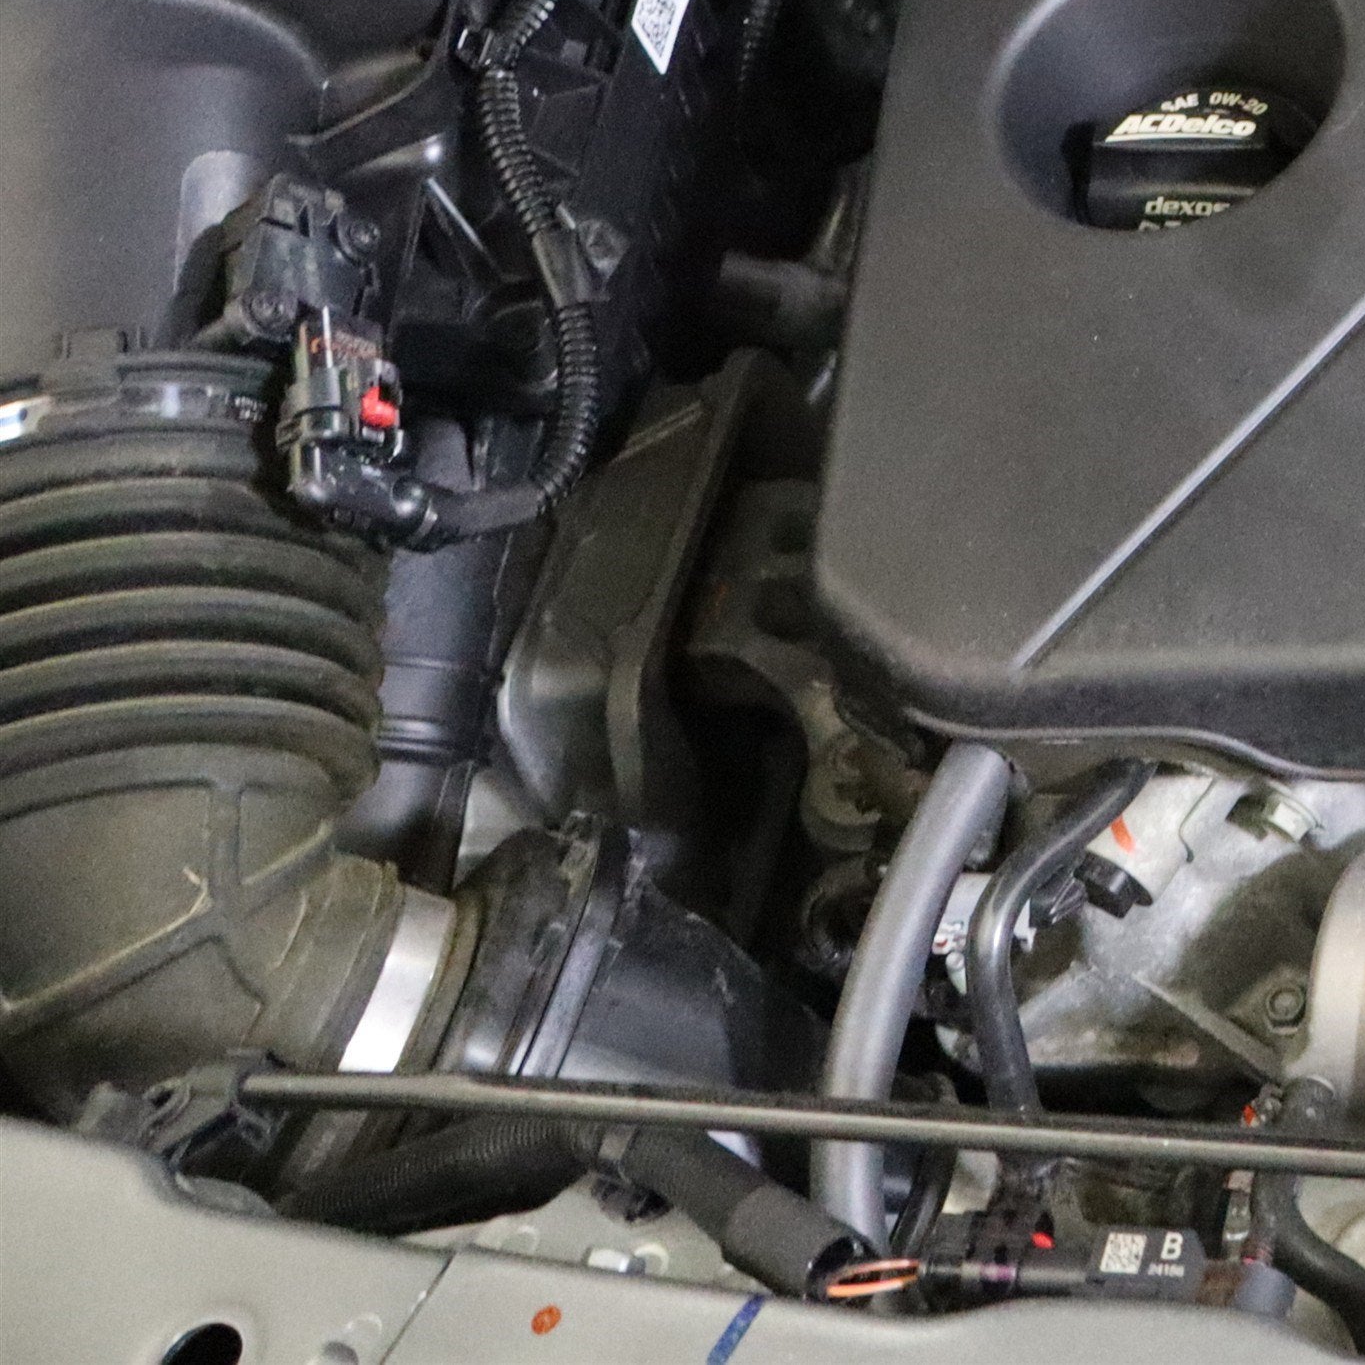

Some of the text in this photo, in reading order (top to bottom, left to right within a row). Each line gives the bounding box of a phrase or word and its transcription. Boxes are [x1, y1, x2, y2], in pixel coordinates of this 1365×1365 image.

[1160, 92, 1268, 115] SAE 0W-20
[1112, 114, 1256, 136] ACDelco
[1160, 1231, 1184, 1260] B
